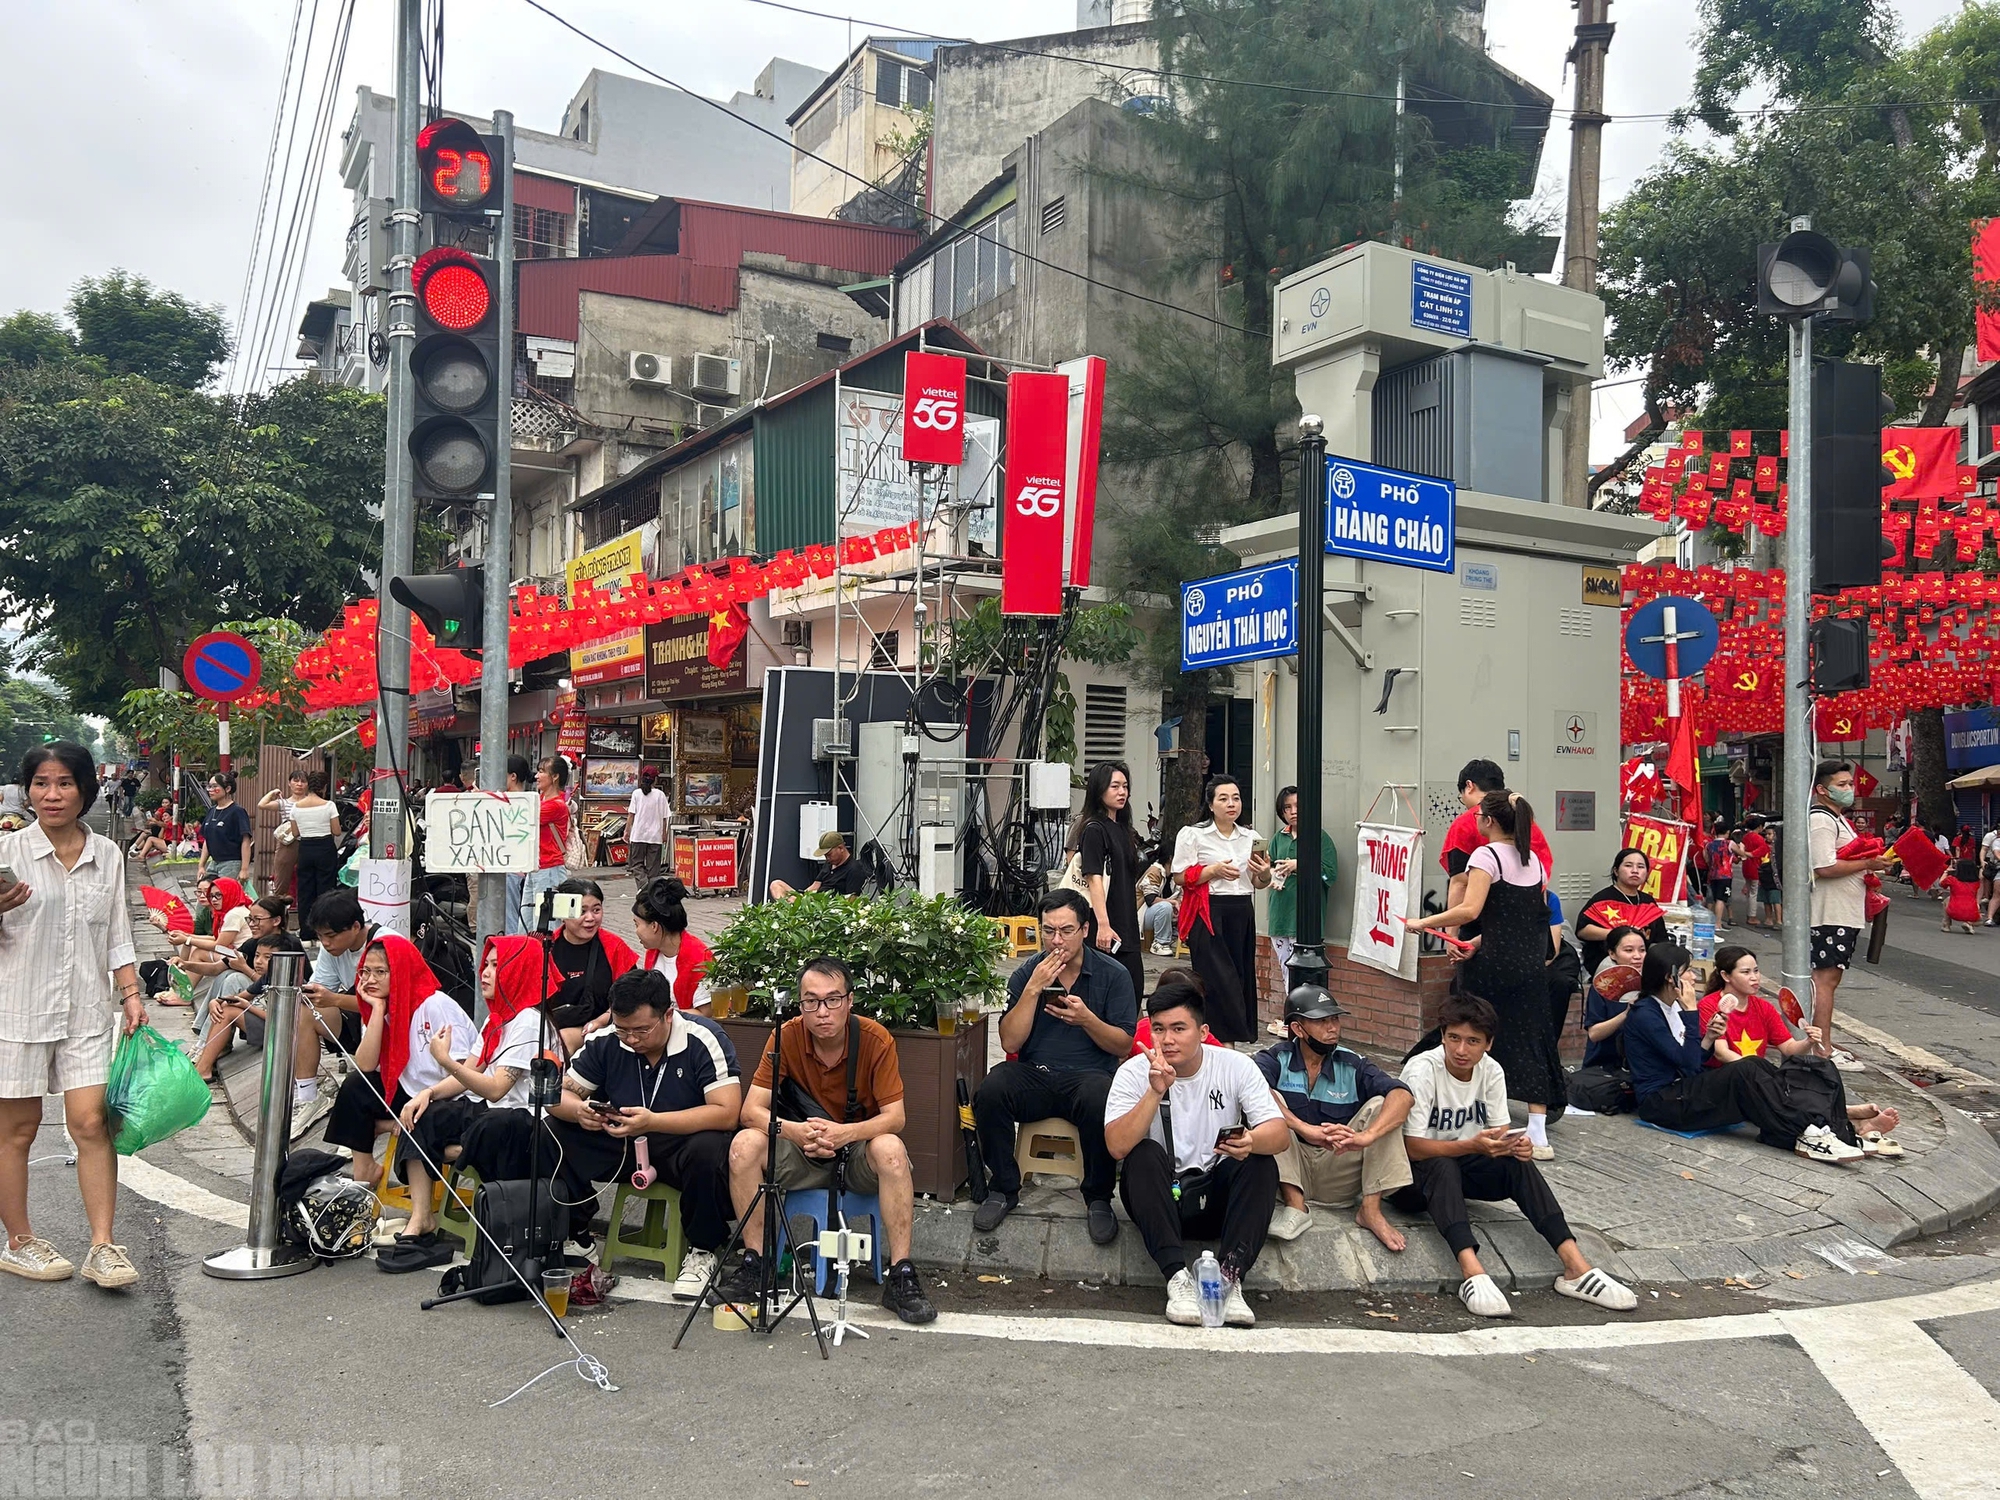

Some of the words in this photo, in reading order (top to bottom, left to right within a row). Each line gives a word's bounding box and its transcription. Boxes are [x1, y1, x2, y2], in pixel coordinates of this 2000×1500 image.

[434, 149, 491, 196] 27
[1420, 300, 1434, 310] CÁT
[1435, 304, 1453, 314] LINH
[1454, 309, 1464, 317] 13
[1423, 290, 1439, 300] TRẠM
[1440, 294, 1453, 304] BIẾN
[1453, 297, 1462, 305] ÁP
[1302, 321, 1318, 335] EVN
[921, 387, 958, 399] viettel
[912, 397, 958, 431] 5G
[1026, 476, 1061, 487] viettel
[1380, 483, 1421, 505] PHỐ
[1016, 486, 1060, 517] 5G
[1335, 502, 1388, 545] HÀNG
[1394, 515, 1444, 555] CHÁO
[607, 545, 630, 573] TRANH
[1226, 574, 1264, 603] PHỐ
[1188, 610, 1230, 654] NGUYỄN
[1234, 608, 1260, 645] THÁI
[1263, 608, 1287, 647] HỌC
[652, 631, 709, 665] TRANH&KH
[1556, 745, 1595, 755] EVNHANOI
[448, 800, 505, 846] BÁN
[449, 844, 511, 867] XĂNG
[699, 843, 712, 851] LÀM
[1629, 823, 1677, 862] TRÀ
[702, 859, 715, 867] LẤY
[715, 859, 732, 867] NGAY
[1366, 835, 1408, 882] TRÔNG
[707, 875, 718, 883] GIÁ
[1638, 864, 1663, 899] Á
[1376, 887, 1390, 925] XE
[1209, 1088, 1225, 1111] NY
